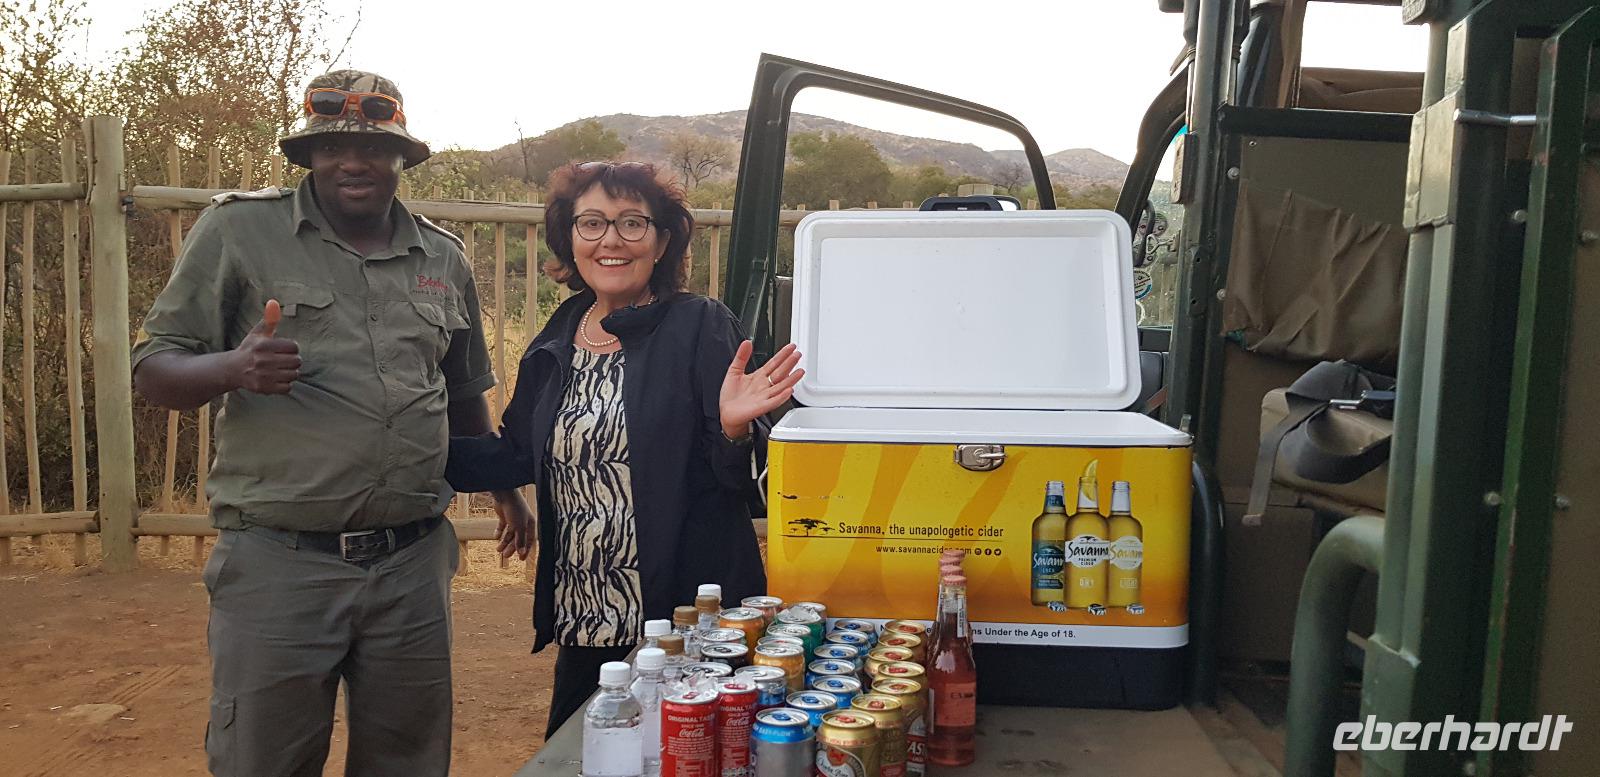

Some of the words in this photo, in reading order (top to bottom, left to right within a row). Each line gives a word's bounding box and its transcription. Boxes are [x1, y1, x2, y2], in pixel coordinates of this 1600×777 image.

[838, 522, 885, 535] Savanna,
[889, 524, 905, 534] the
[909, 524, 974, 538] unapologetic
[977, 525, 1004, 537] cider
[876, 545, 972, 554] www.savannacidm
[984, 627, 1012, 636] Under
[1014, 628, 1029, 637] the
[1030, 629, 1049, 639] Age
[1051, 629, 1061, 638] of
[1063, 630, 1076, 638] 18.
[667, 714, 698, 723] ORIGINAL
